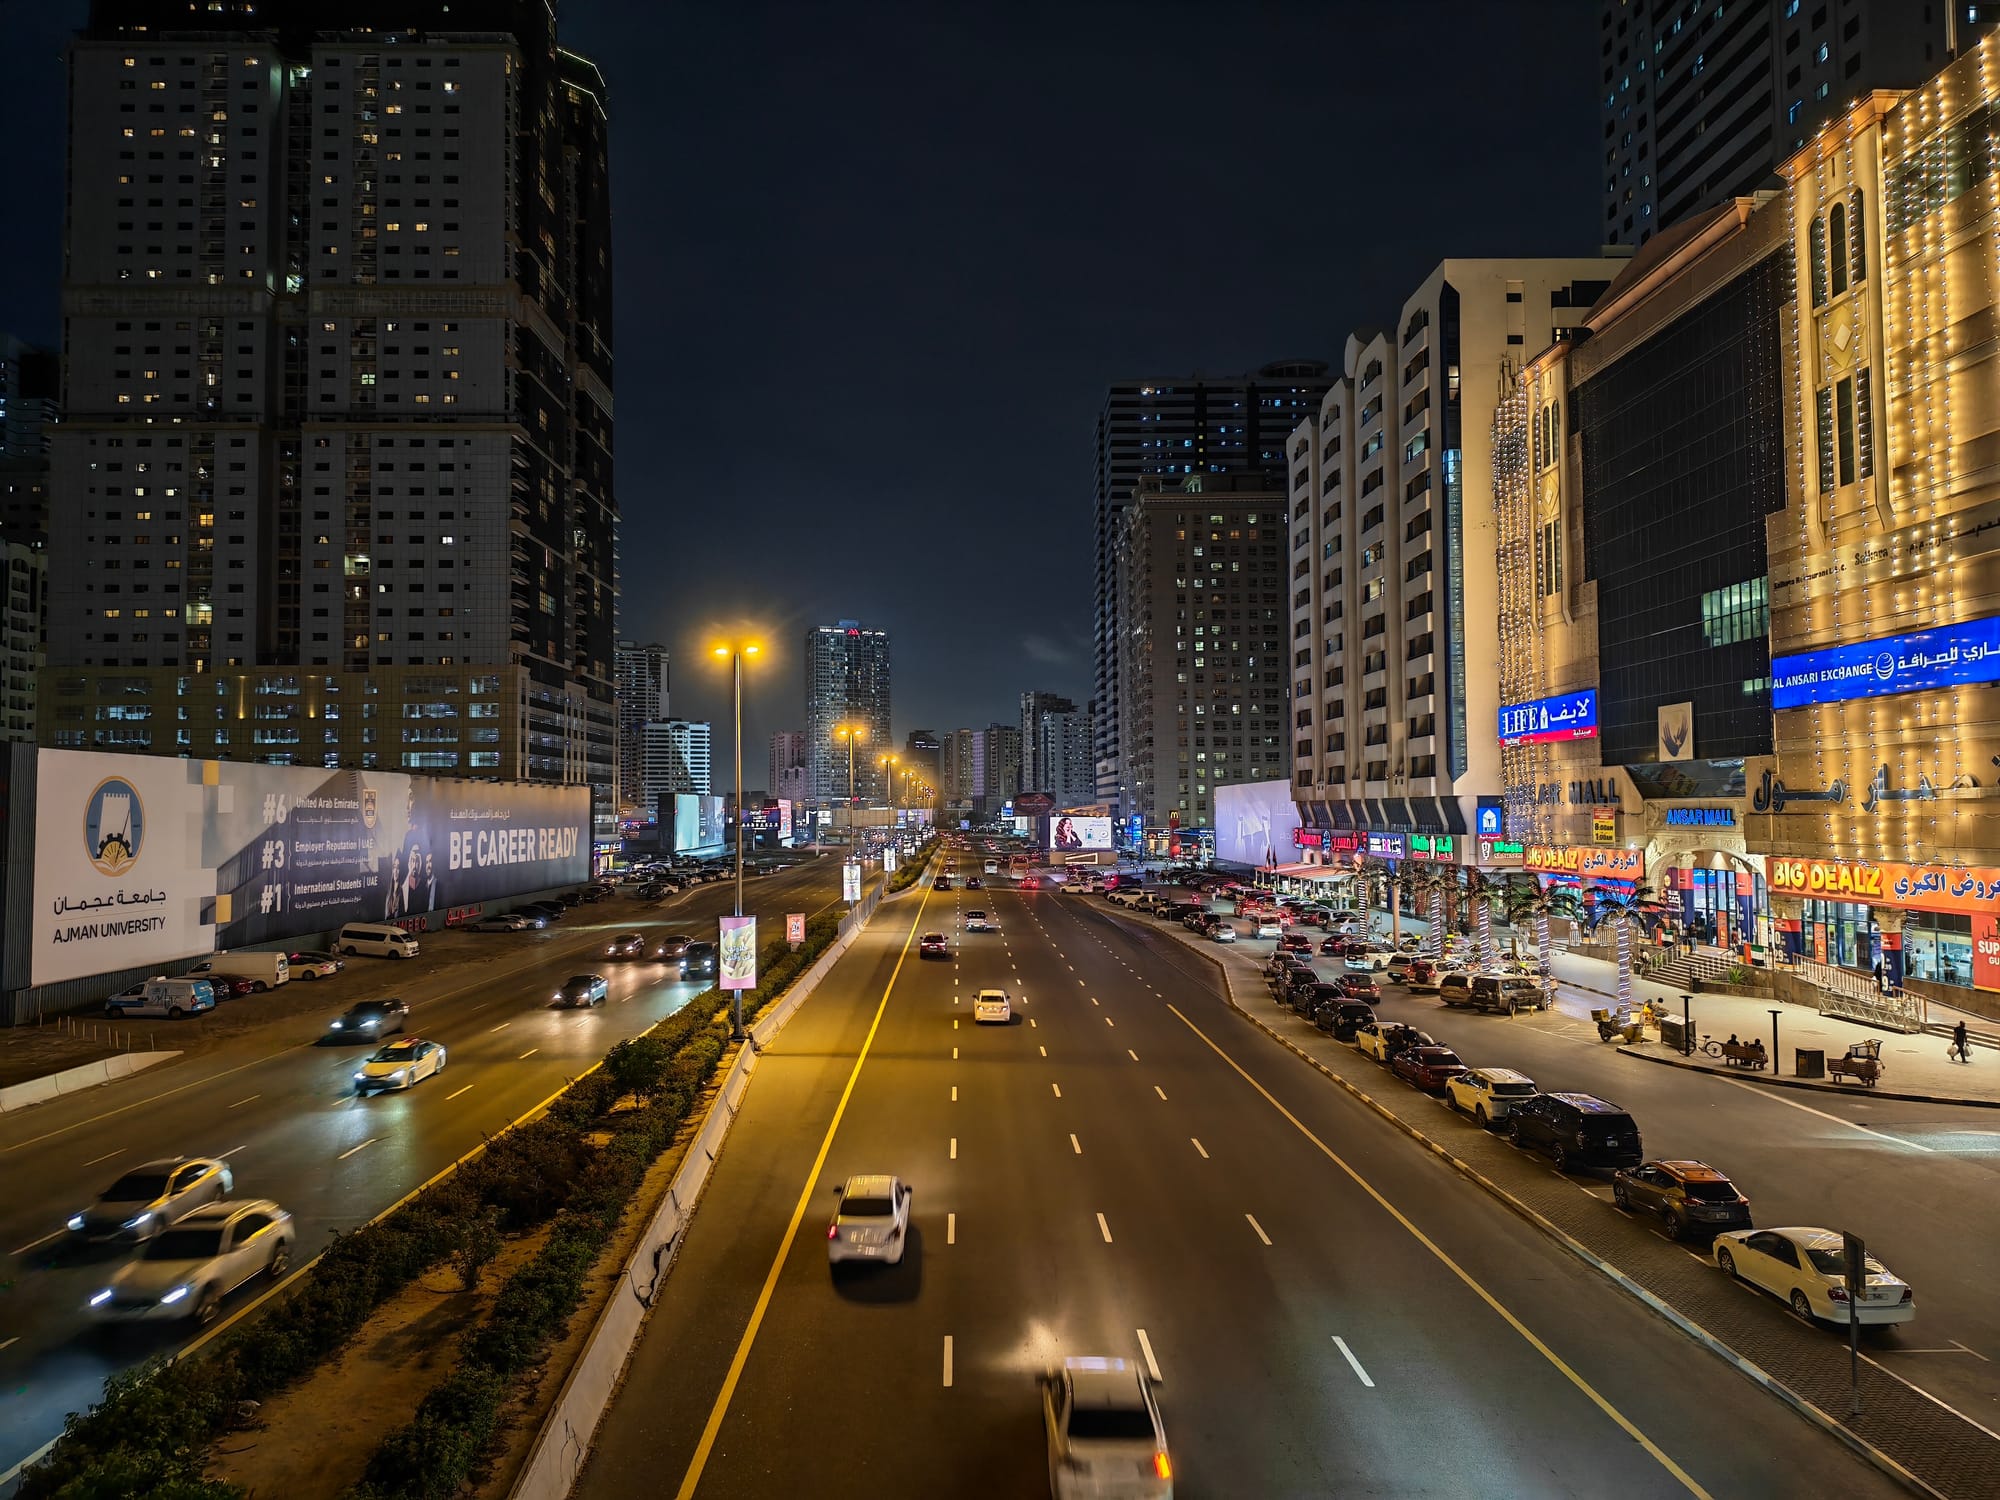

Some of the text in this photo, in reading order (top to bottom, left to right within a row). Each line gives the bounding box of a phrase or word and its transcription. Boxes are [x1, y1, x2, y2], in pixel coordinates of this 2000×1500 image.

[1896, 646, 1959, 670] للصرافة
[1773, 662, 1873, 690] AL ANSARI EXCHANGE
[1503, 706, 1539, 735] LIFE
[1550, 697, 1590, 725] لايف
[296, 795, 360, 809] United Arab Emirates
[1567, 777, 1622, 805] MALL
[1752, 768, 1846, 813] مول
[263, 793, 287, 825] #6
[1666, 808, 1735, 827] ANSAR MALL
[262, 839, 286, 869] #3
[295, 837, 375, 855] Employer Reputation UAE
[449, 826, 579, 871] BE CAREER READY
[1526, 847, 1542, 867] BIG
[1544, 847, 1579, 870] DEALZ
[294, 875, 379, 895] International Students UAE
[1773, 861, 1883, 896] BIG DEALZ
[53, 888, 167, 916] جامعة عجمان
[261, 883, 283, 915] #1
[52, 916, 167, 945] AJMAN UNIVERSITY
